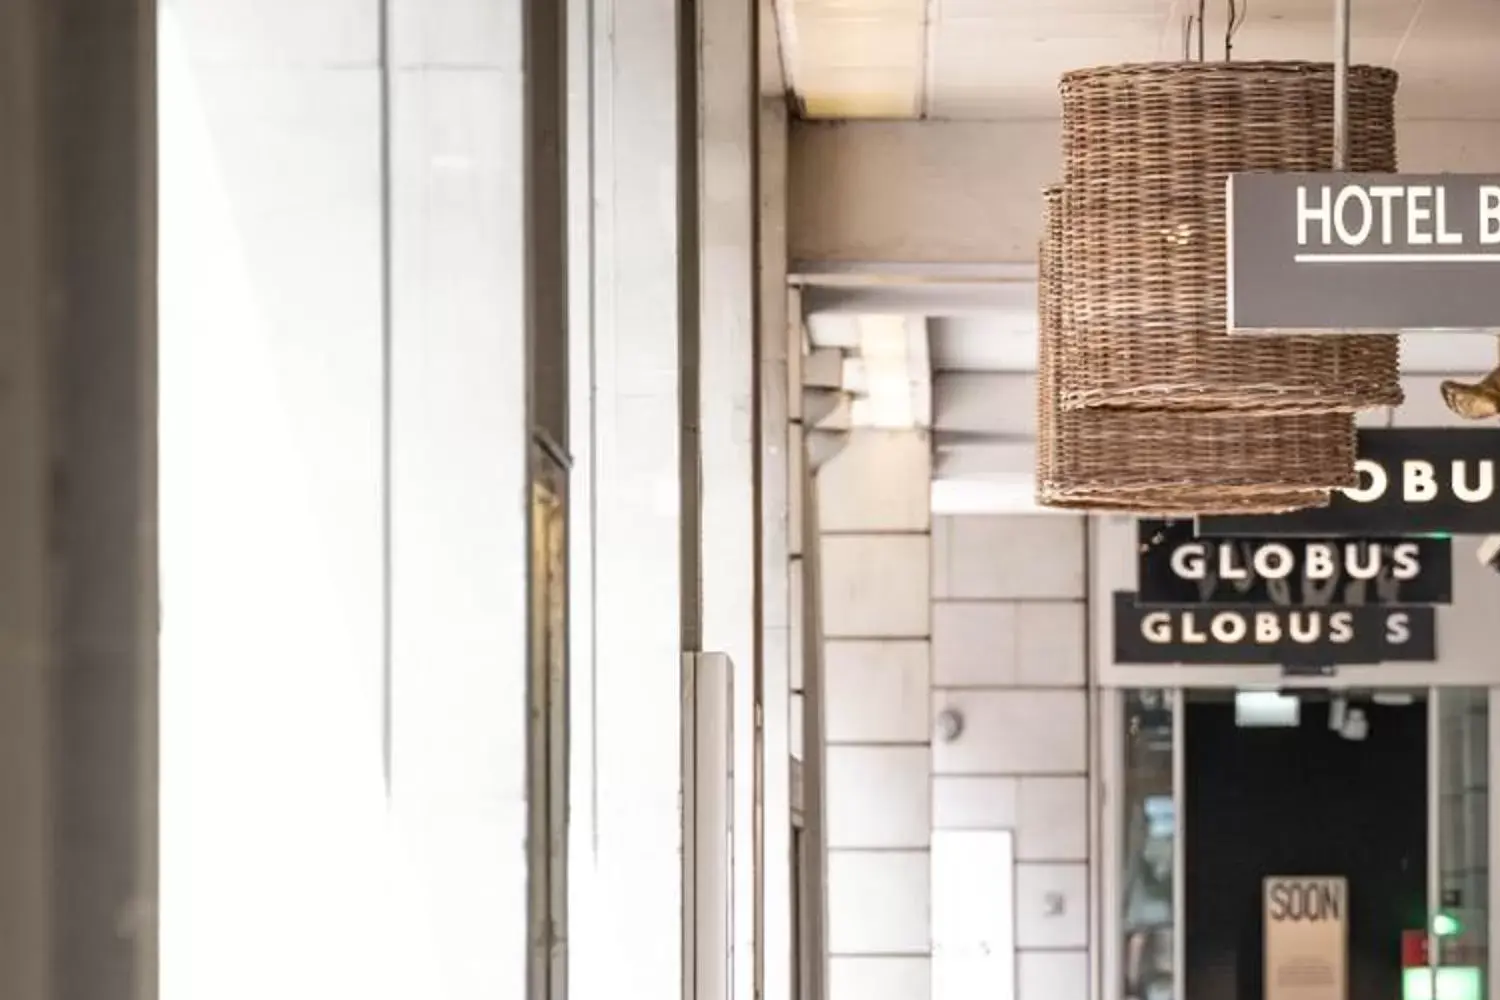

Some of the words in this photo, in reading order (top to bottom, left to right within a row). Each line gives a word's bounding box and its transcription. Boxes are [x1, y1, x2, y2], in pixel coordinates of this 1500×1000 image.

[1296, 184, 1463, 246] HOTEL
[1170, 543, 1421, 580] GLOBUS
[1140, 611, 1354, 644] GLOBUS
[1270, 882, 1340, 922] SOON
